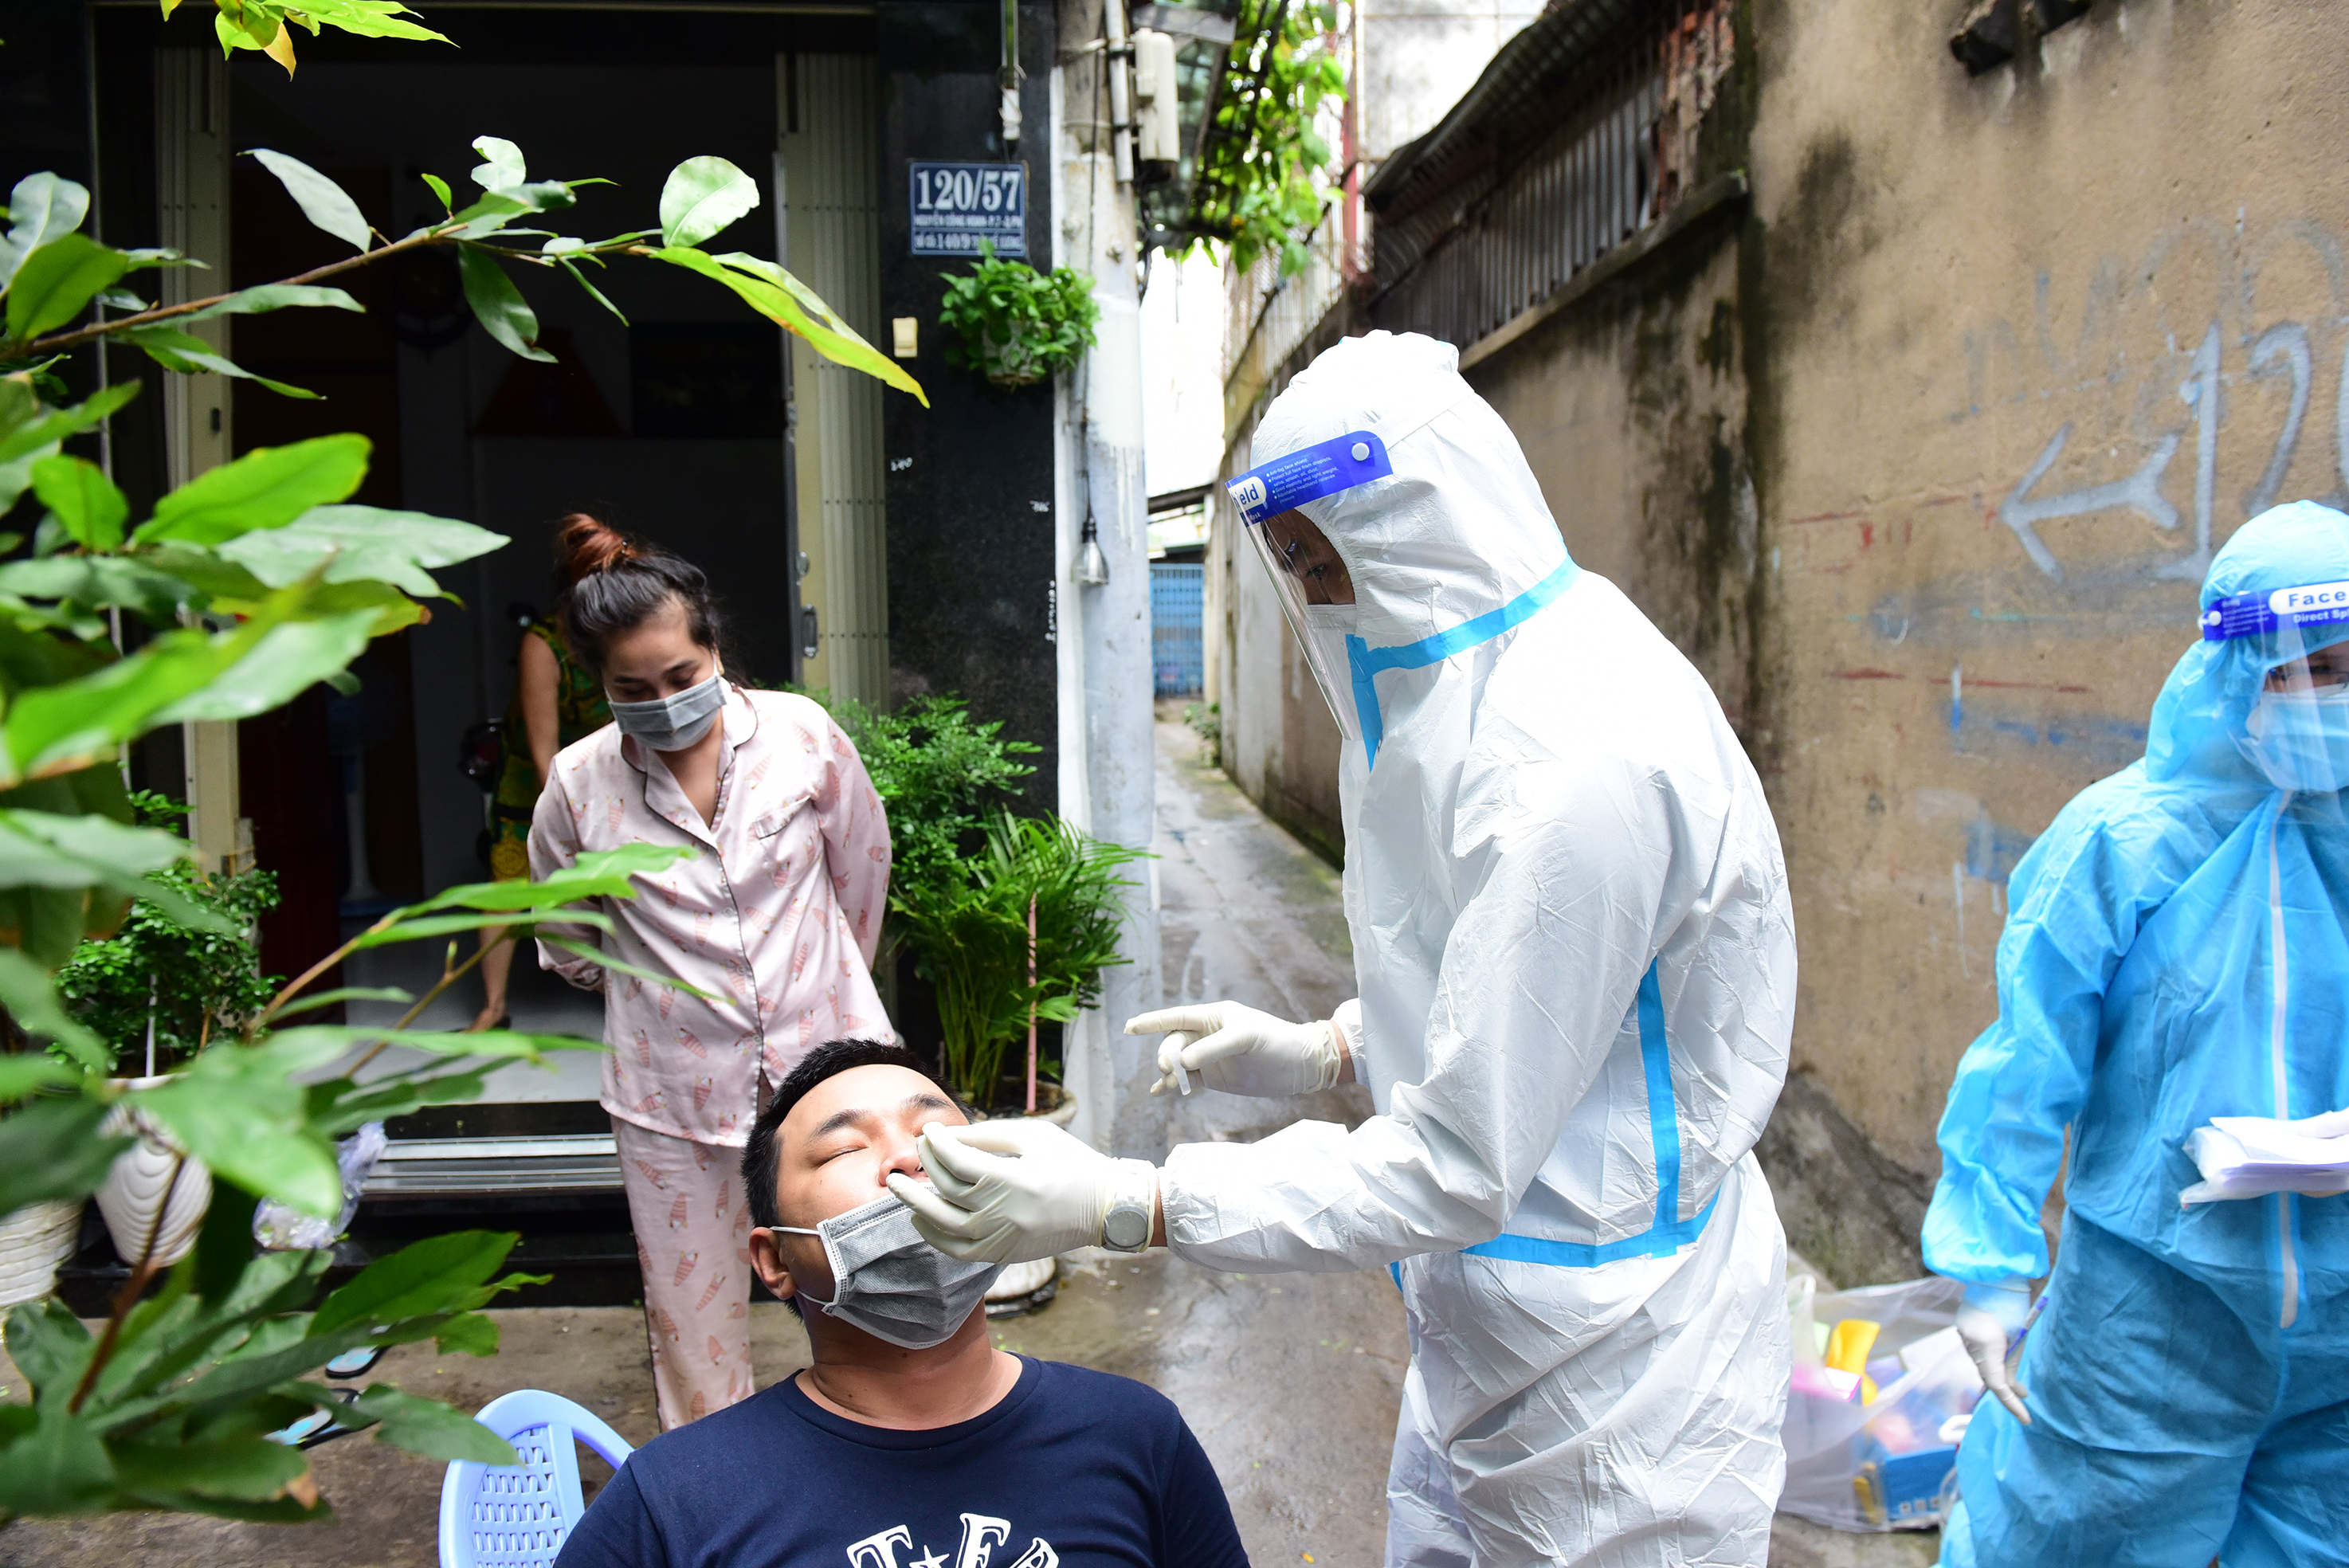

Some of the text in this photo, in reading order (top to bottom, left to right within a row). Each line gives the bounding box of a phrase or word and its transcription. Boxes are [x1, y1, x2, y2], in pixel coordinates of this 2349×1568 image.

[916, 168, 1022, 212] 120/57
[2288, 591, 2347, 608] Face
[2293, 610, 2330, 624] Direct
